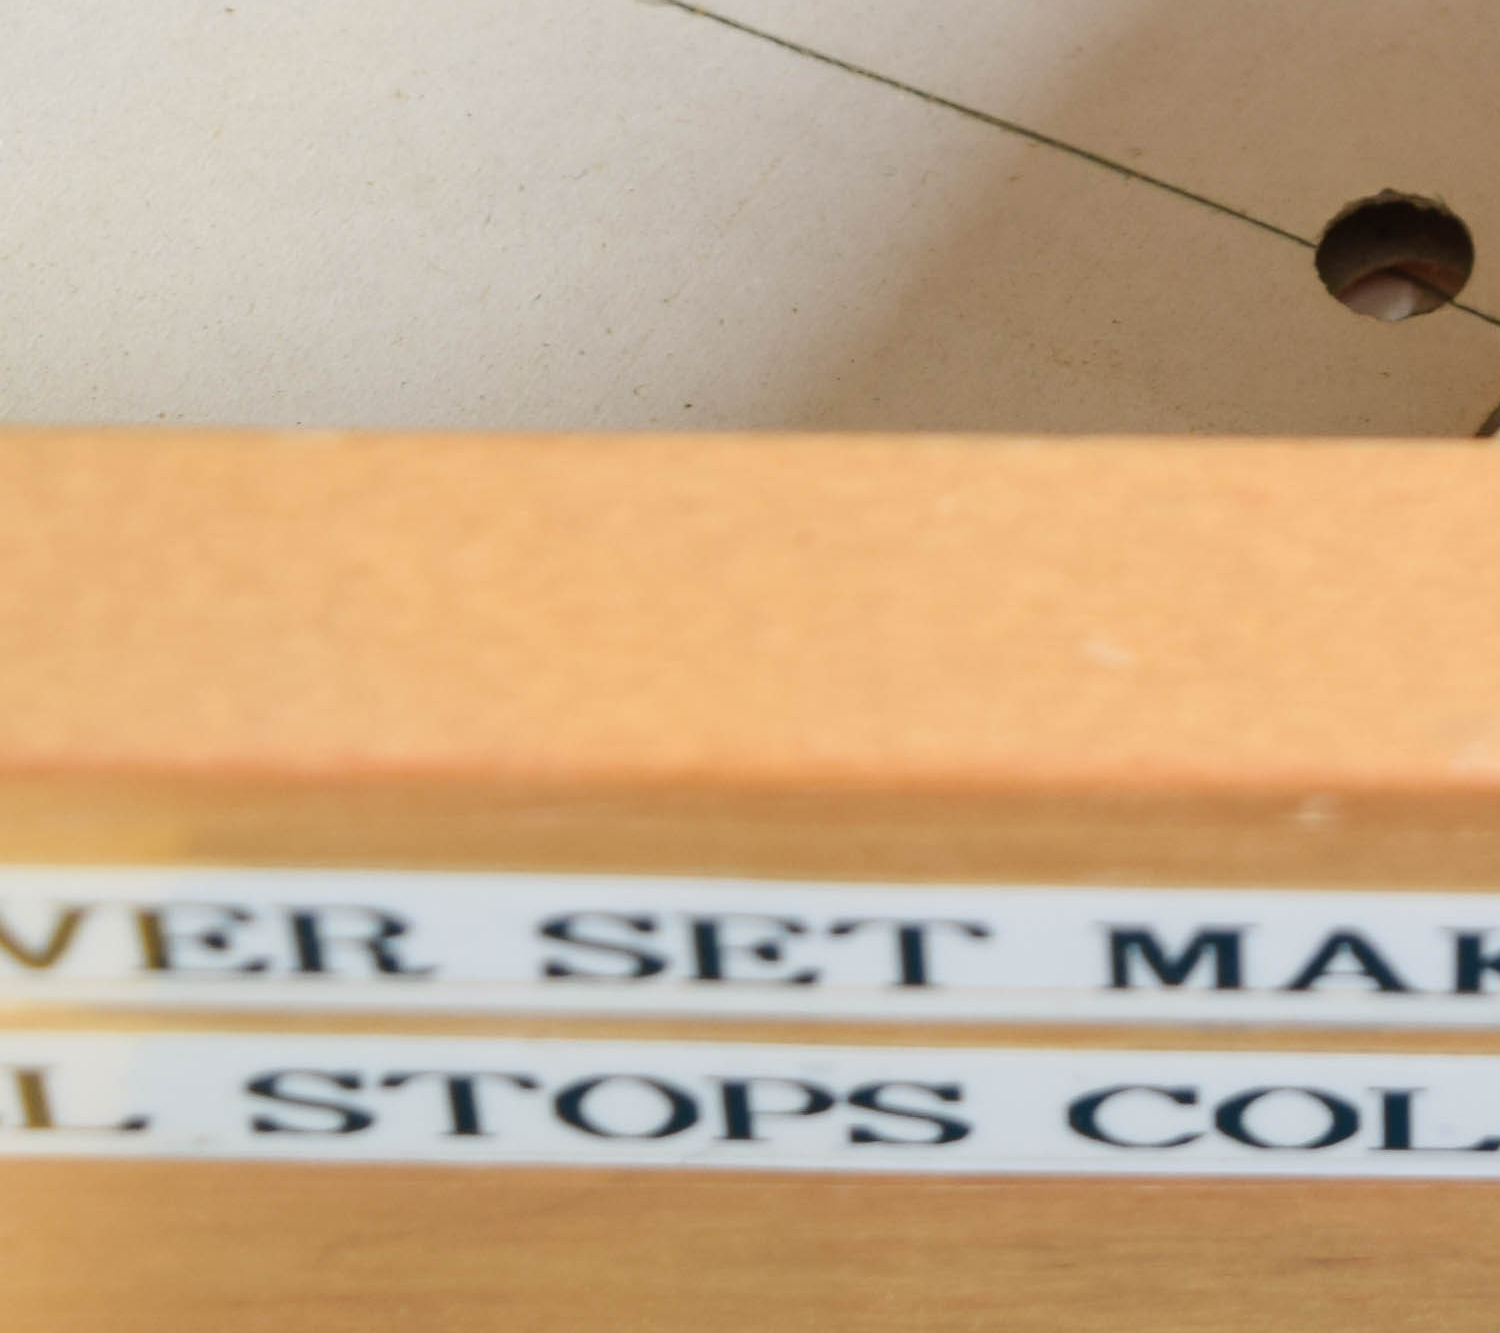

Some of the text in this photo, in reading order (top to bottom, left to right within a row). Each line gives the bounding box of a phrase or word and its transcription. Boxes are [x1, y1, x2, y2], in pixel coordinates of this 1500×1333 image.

[0, 901, 440, 981] VER
[535, 910, 990, 983] SET
[244, 1067, 976, 1146] STOPS
